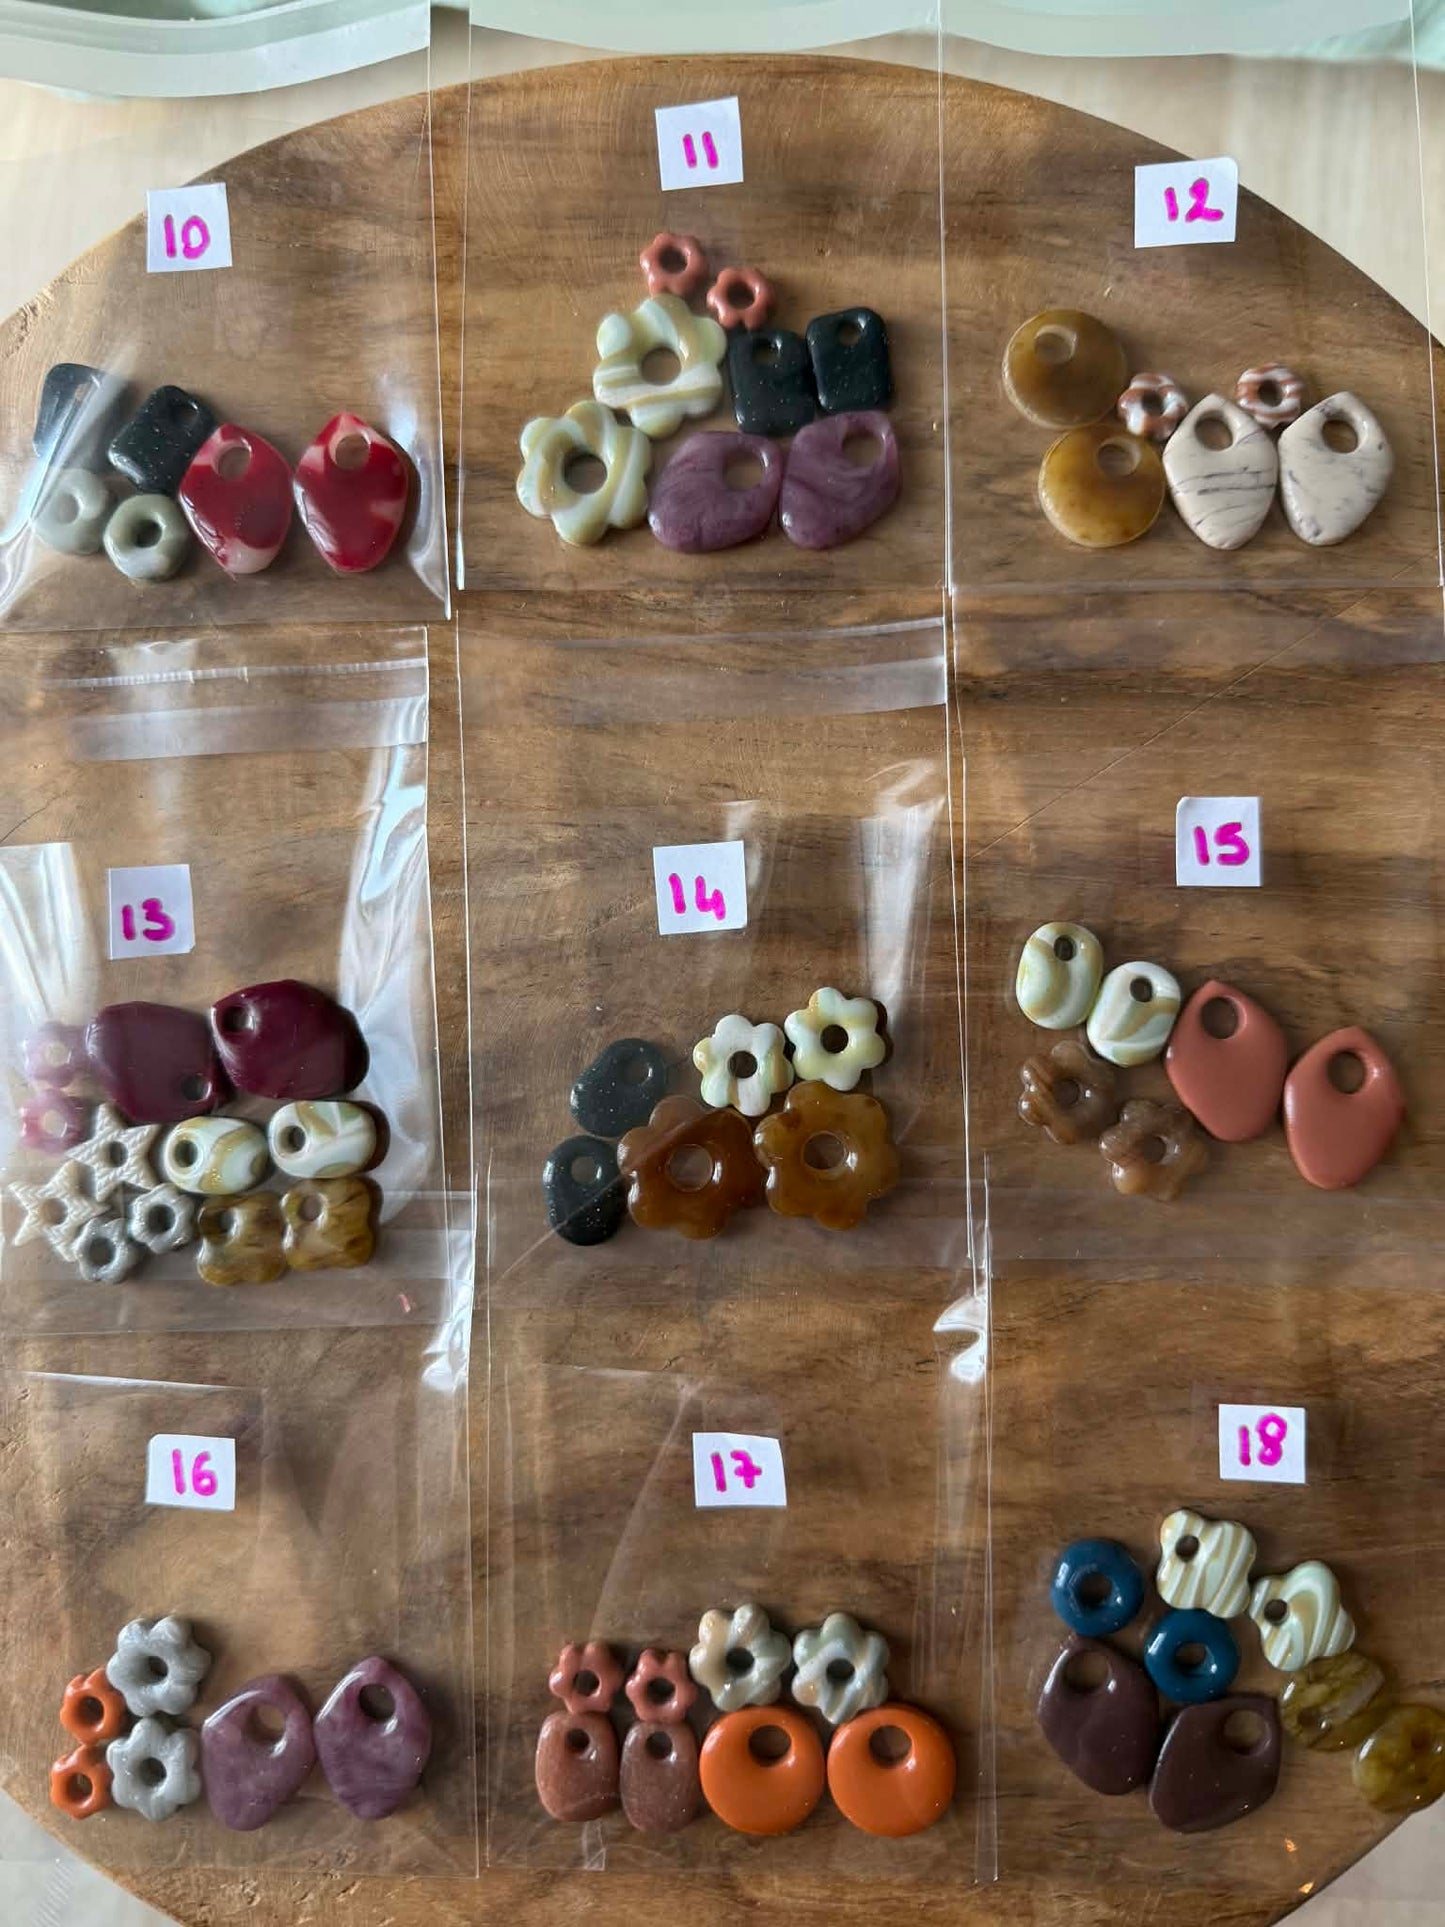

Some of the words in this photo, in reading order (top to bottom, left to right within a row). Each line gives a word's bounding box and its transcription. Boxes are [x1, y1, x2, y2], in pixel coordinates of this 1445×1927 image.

[682, 131, 719, 169] 11
[1164, 178, 1224, 223] 12
[164, 214, 210, 260] 10
[1193, 822, 1250, 866] 15
[668, 873, 726, 921] 14
[121, 898, 175, 942] 13
[1238, 1413, 1288, 1467] 18
[171, 1449, 217, 1497] 16
[710, 1449, 762, 1493] 17
